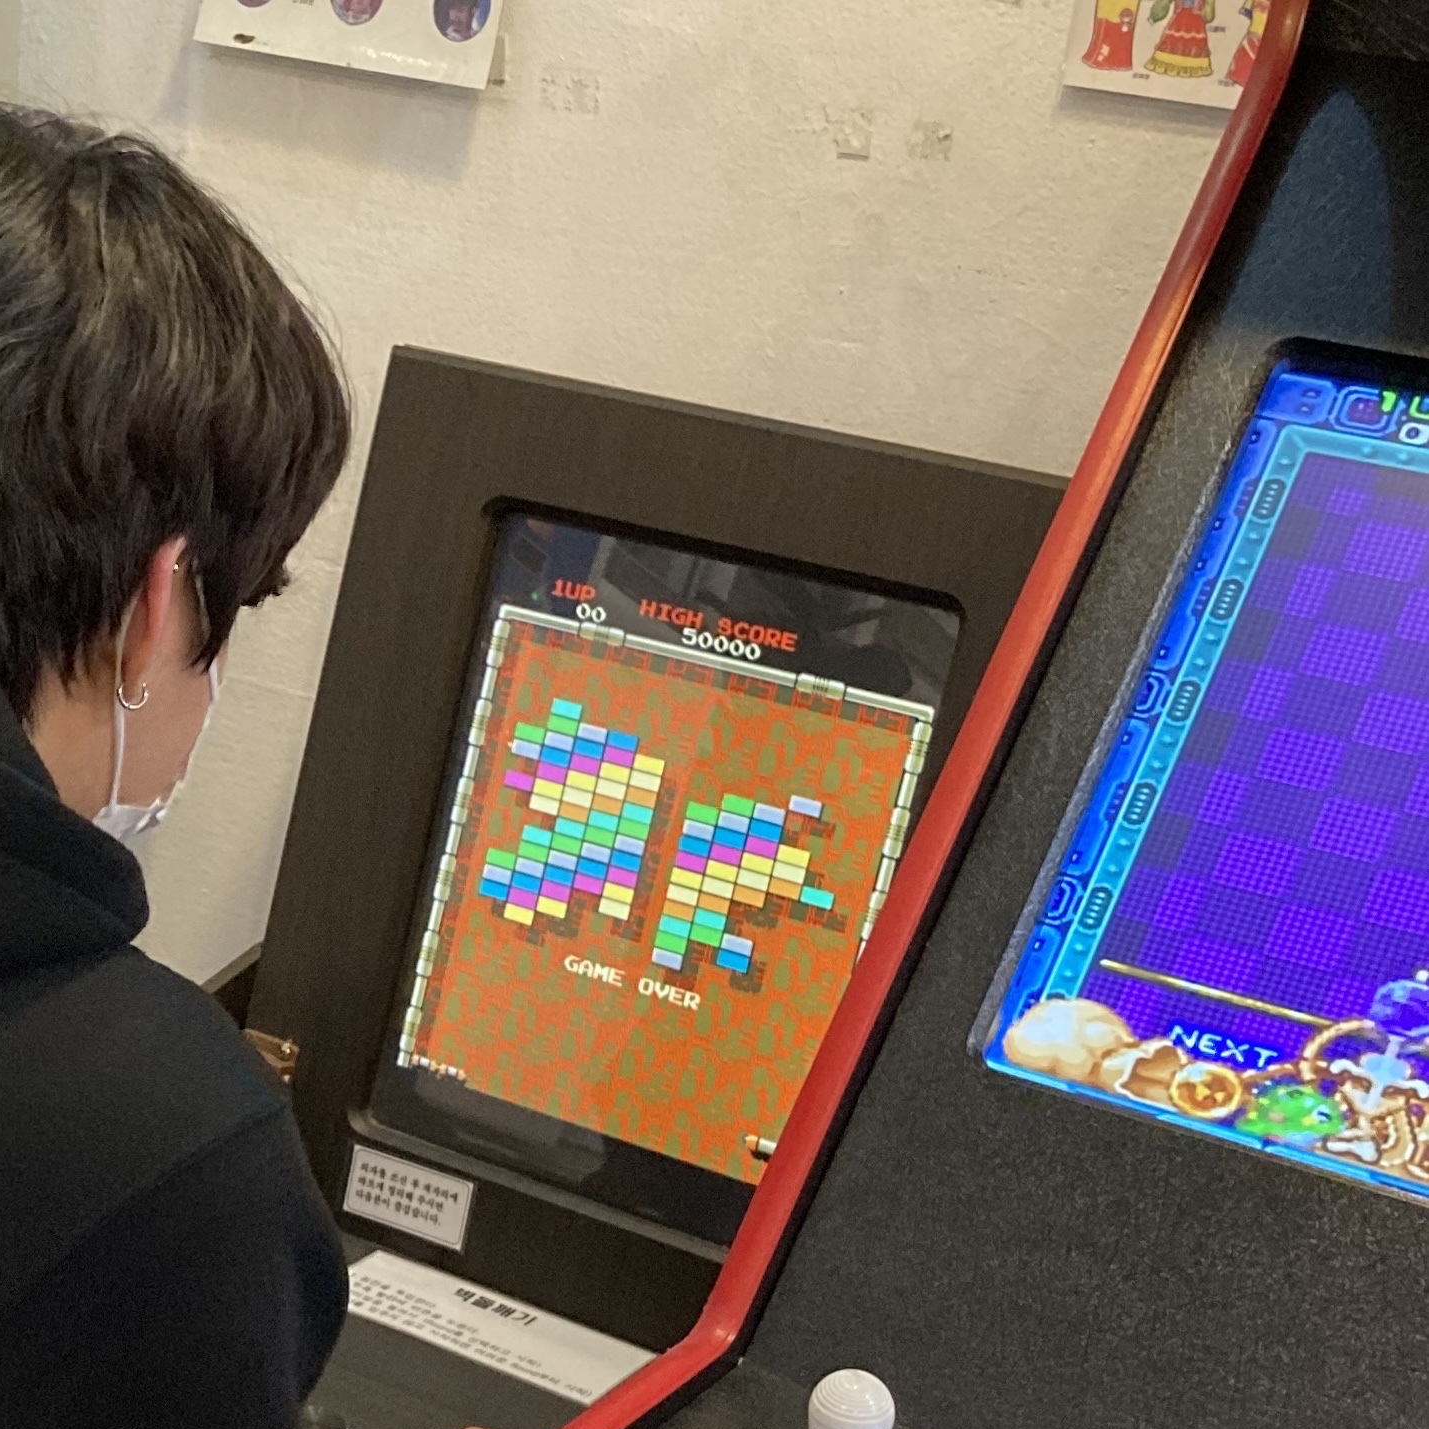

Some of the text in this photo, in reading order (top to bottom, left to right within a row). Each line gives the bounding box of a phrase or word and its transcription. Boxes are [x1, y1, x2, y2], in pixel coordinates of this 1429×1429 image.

[552, 578, 596, 603] 1UP
[576, 601, 607, 624] 00
[639, 598, 799, 653] HIGH SCORE
[681, 626, 762, 661] 50000
[563, 954, 702, 1012] GAME OVER
[1170, 1025, 1278, 1068] NEXT
